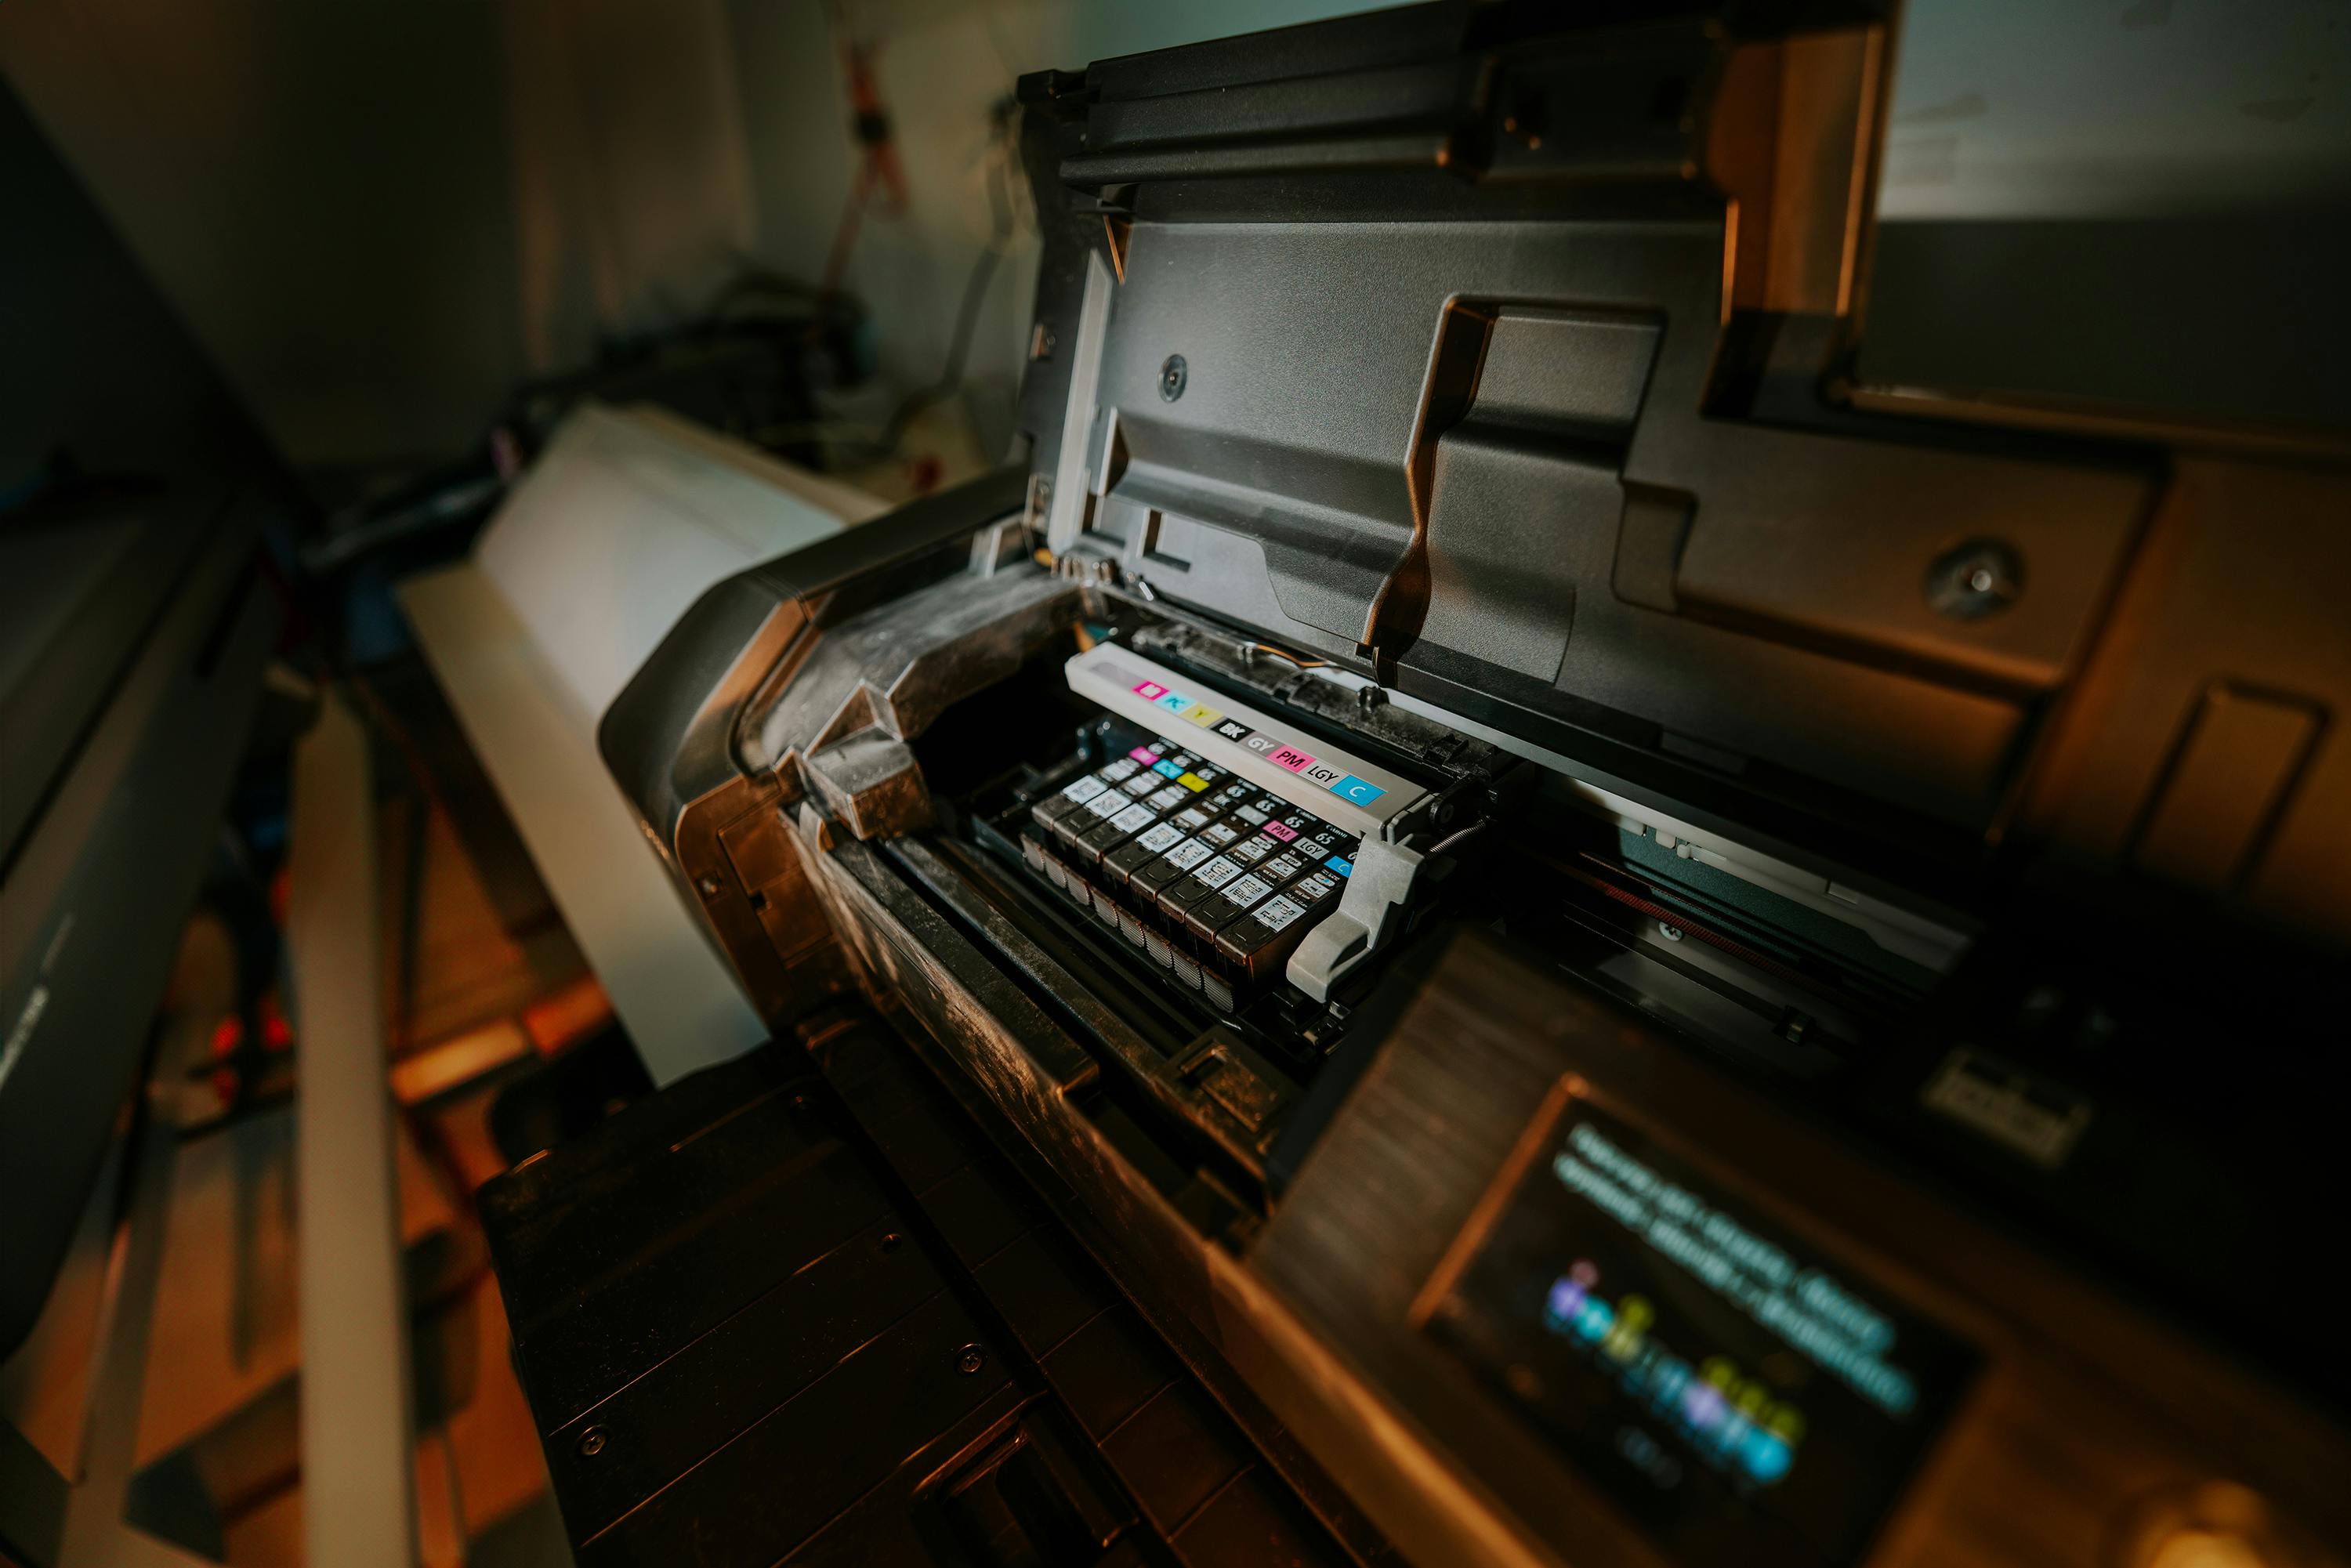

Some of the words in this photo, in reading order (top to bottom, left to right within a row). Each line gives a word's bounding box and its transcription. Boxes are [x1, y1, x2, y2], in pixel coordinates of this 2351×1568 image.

[1219, 722, 1246, 739] BK
[1248, 737, 1275, 752] GY
[1276, 751, 1306, 768] PM
[1307, 766, 1339, 783] LGY
[1349, 786, 1367, 798] C
[1255, 799, 1276, 813] 65
[1284, 816, 1305, 828] 65
[1271, 824, 1291, 838] PM
[1315, 832, 1335, 845] 65
[1299, 841, 1323, 855] LGY
[1347, 852, 1357, 863] 6
